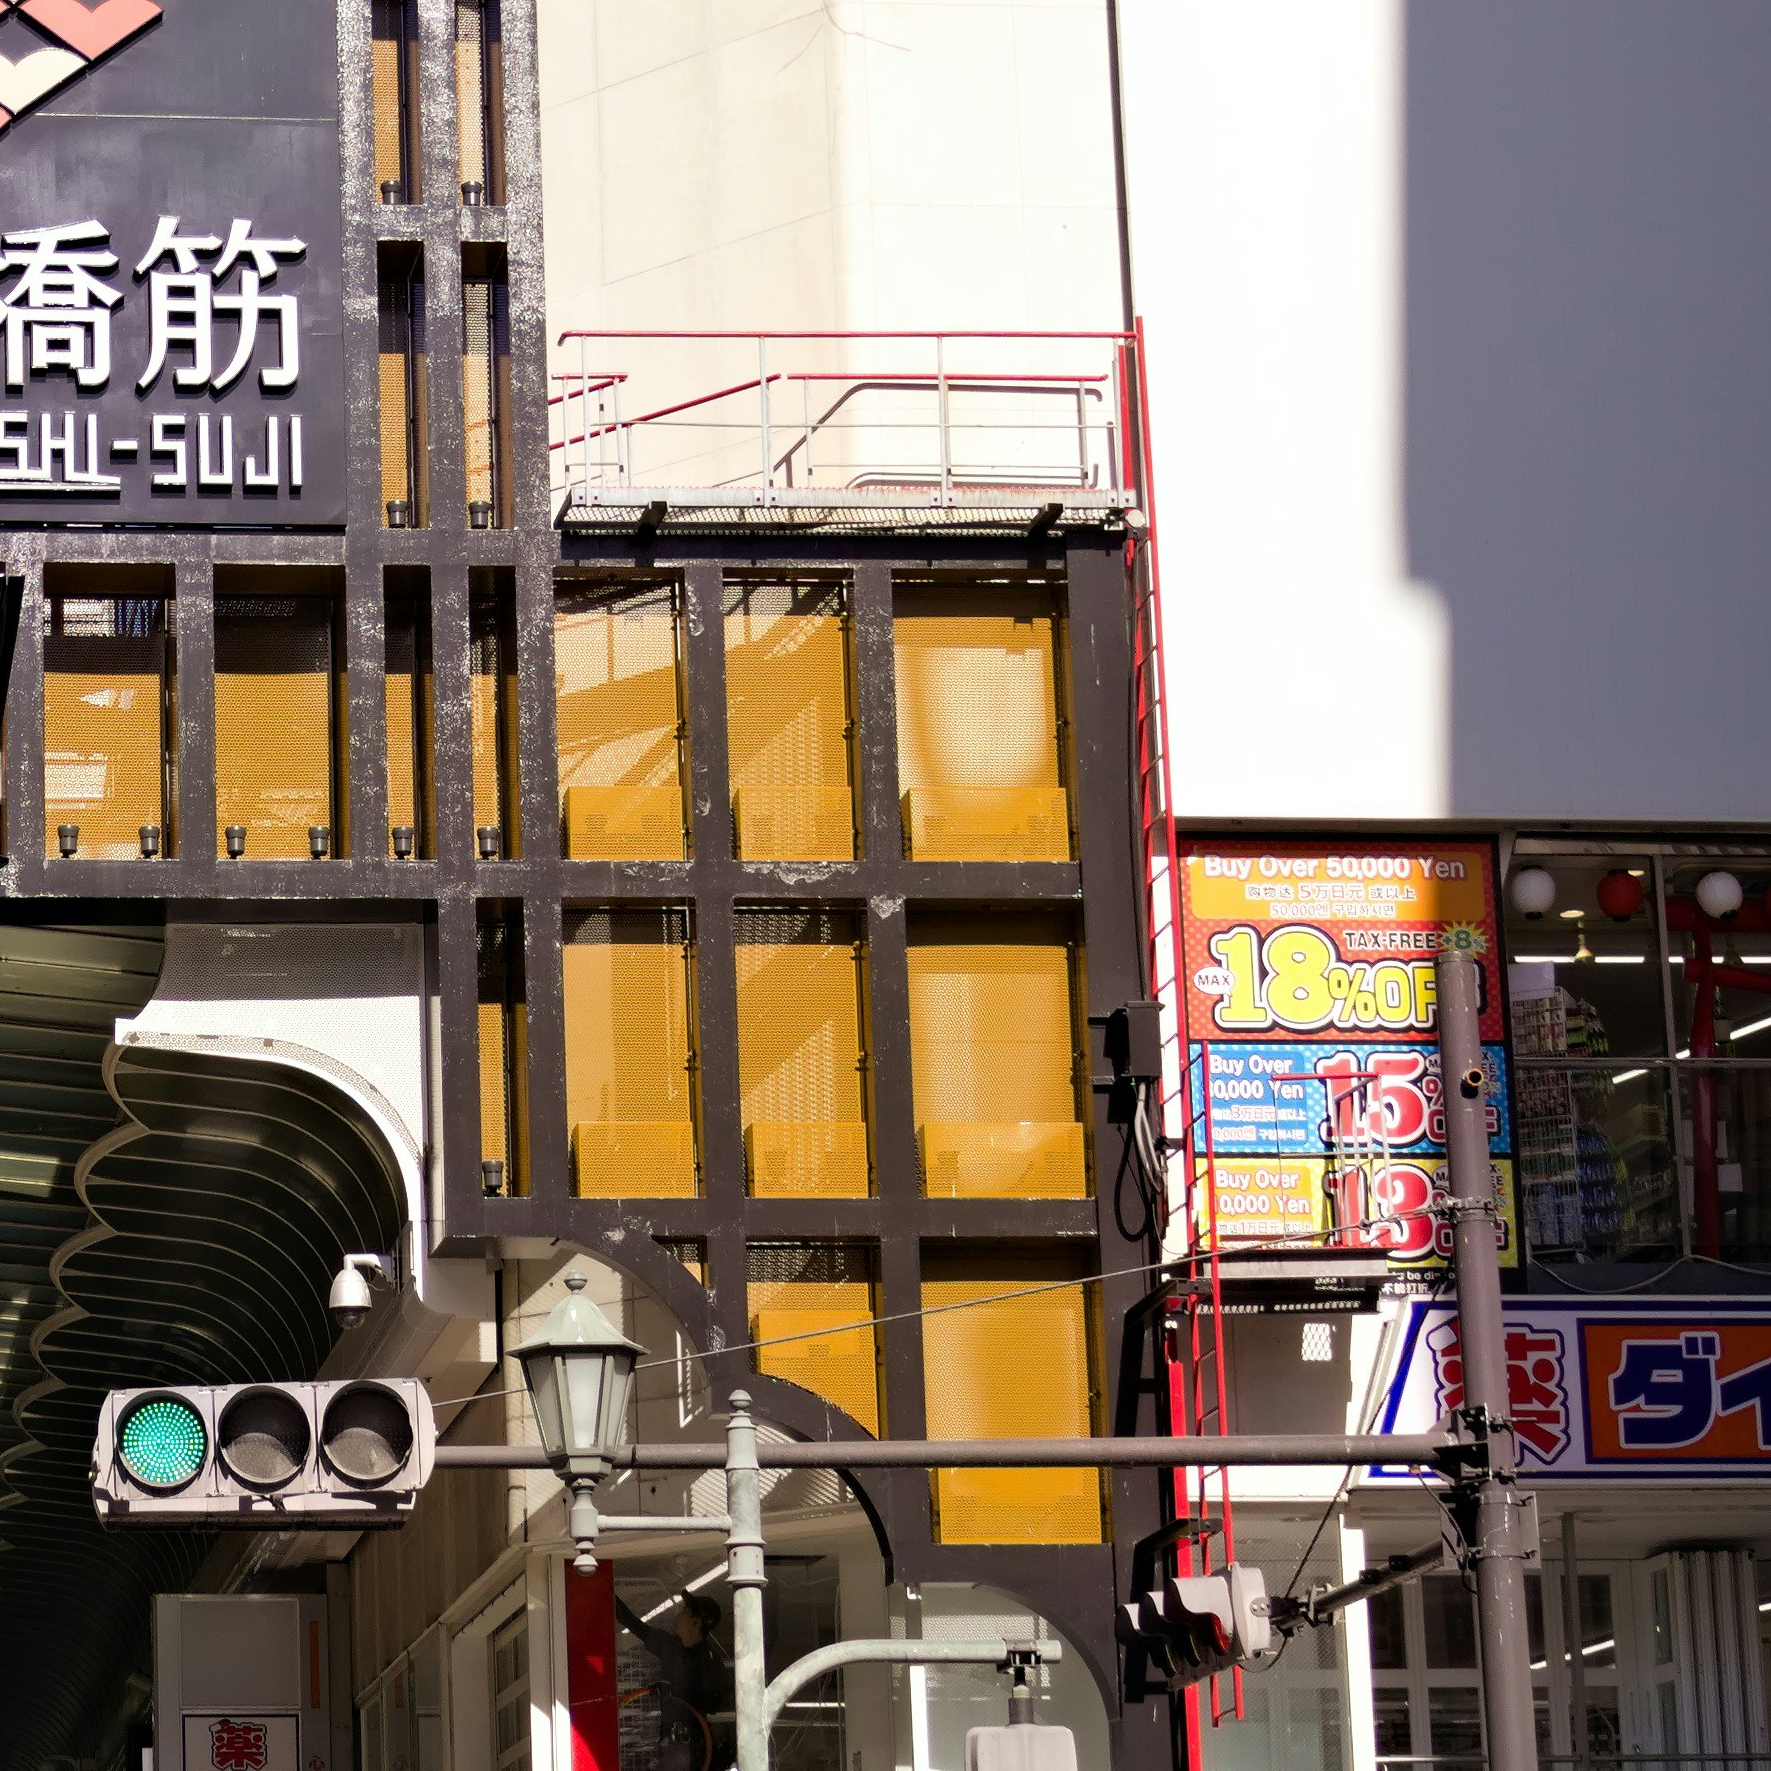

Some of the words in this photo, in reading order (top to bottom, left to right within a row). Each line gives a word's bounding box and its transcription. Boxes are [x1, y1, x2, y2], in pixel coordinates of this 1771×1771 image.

[1203, 853, 1253, 881] Buy
[1258, 855, 1319, 879] Over
[1325, 856, 1411, 881] 50,000
[1417, 856, 1466, 879] Yen
[1297, 883, 1364, 901] 5万日元
[1344, 930, 1437, 951] TAX-FREE
[1196, 973, 1231, 987] MAX
[1208, 1054, 1245, 1076] Buy
[1248, 1054, 1294, 1075] Over
[1270, 1080, 1304, 1100] Yen
[1215, 1169, 1252, 1191] Buy
[1254, 1169, 1300, 1189] Over
[1275, 1195, 1311, 1215] Yen
